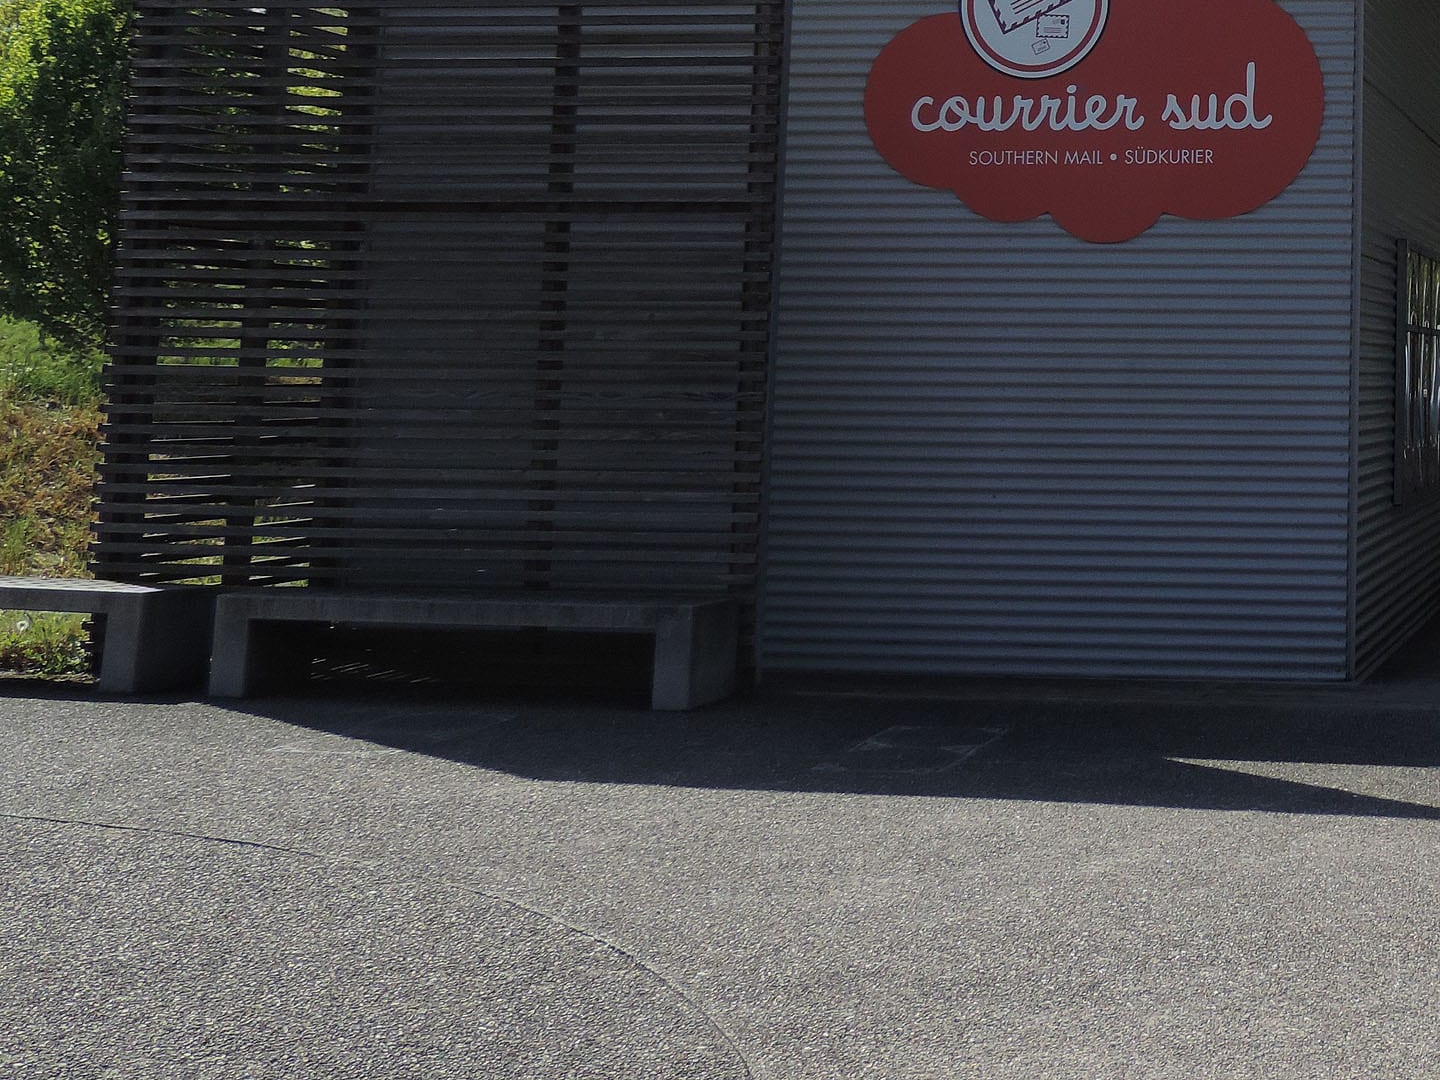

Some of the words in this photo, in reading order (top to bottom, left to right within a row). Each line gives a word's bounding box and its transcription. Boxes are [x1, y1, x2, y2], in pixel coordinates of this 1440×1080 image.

[911, 84, 1145, 132] courrier
[1161, 61, 1273, 130] sud
[968, 150, 1058, 166] SOUTHERN
[1064, 150, 1104, 165] MAIL
[1124, 146, 1214, 166] SÜDKURIER
